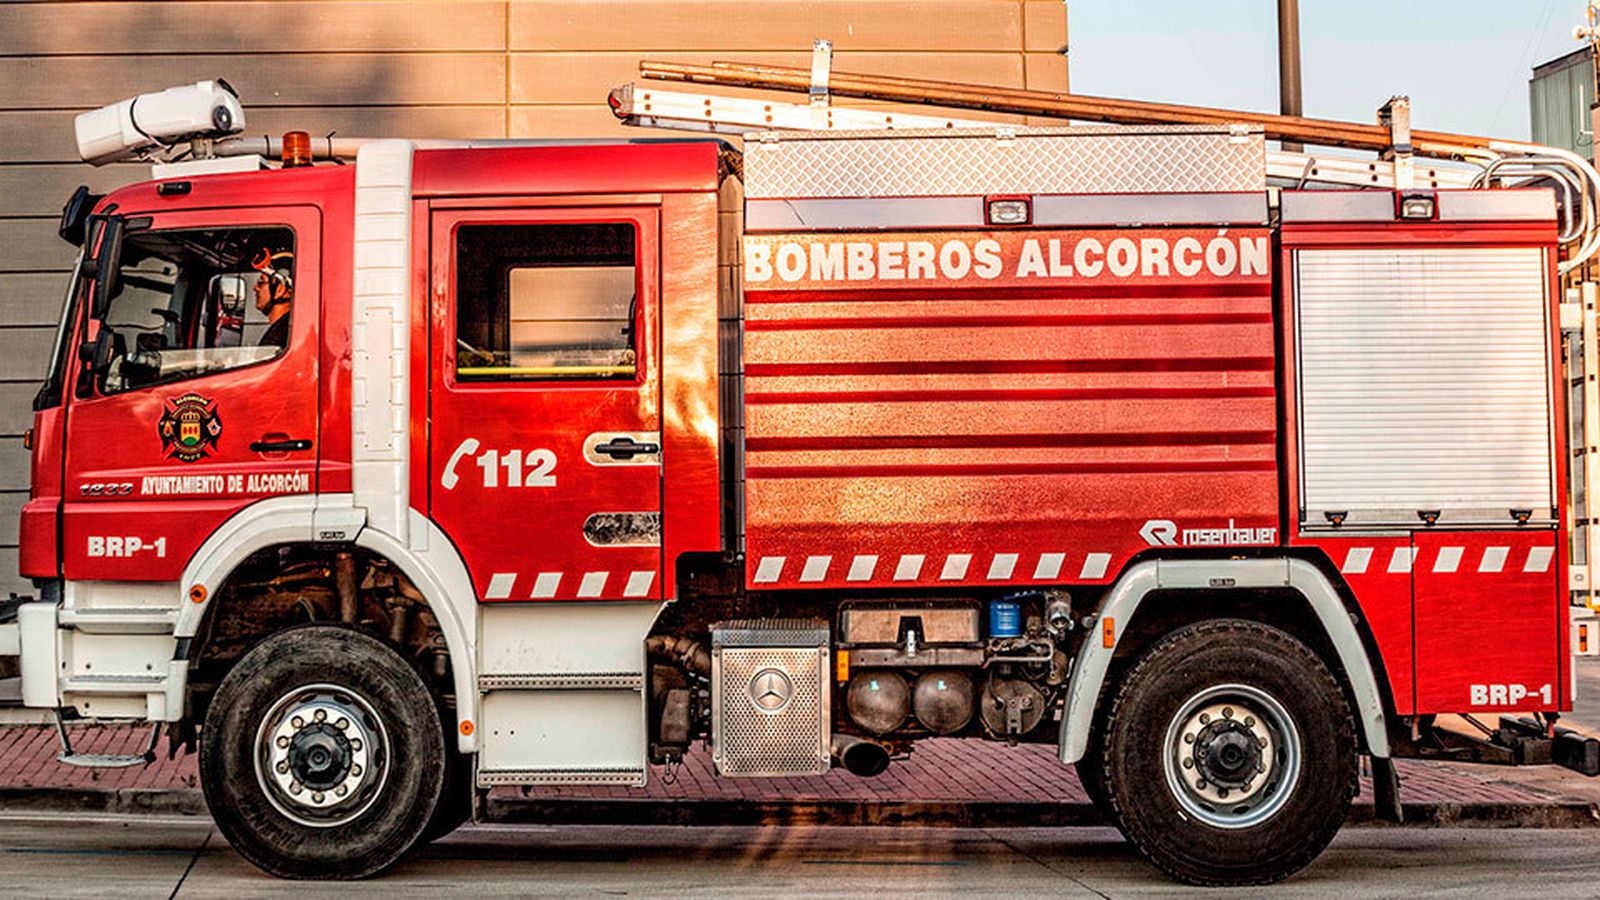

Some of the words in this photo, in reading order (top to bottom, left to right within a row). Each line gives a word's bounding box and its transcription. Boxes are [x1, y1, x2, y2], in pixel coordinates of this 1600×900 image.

[744, 239, 1003, 282] BOMBEROS
[1016, 231, 1268, 278] ALCORCÓN
[476, 448, 558, 488] 112
[141, 476, 224, 494] AYUNTAMIENTO
[227, 474, 244, 493] DE
[246, 470, 309, 493] ALCORCÓN
[1182, 518, 1277, 545] rosenbauer
[87, 535, 167, 558] BRP-1
[1470, 684, 1552, 706] BRP-1
